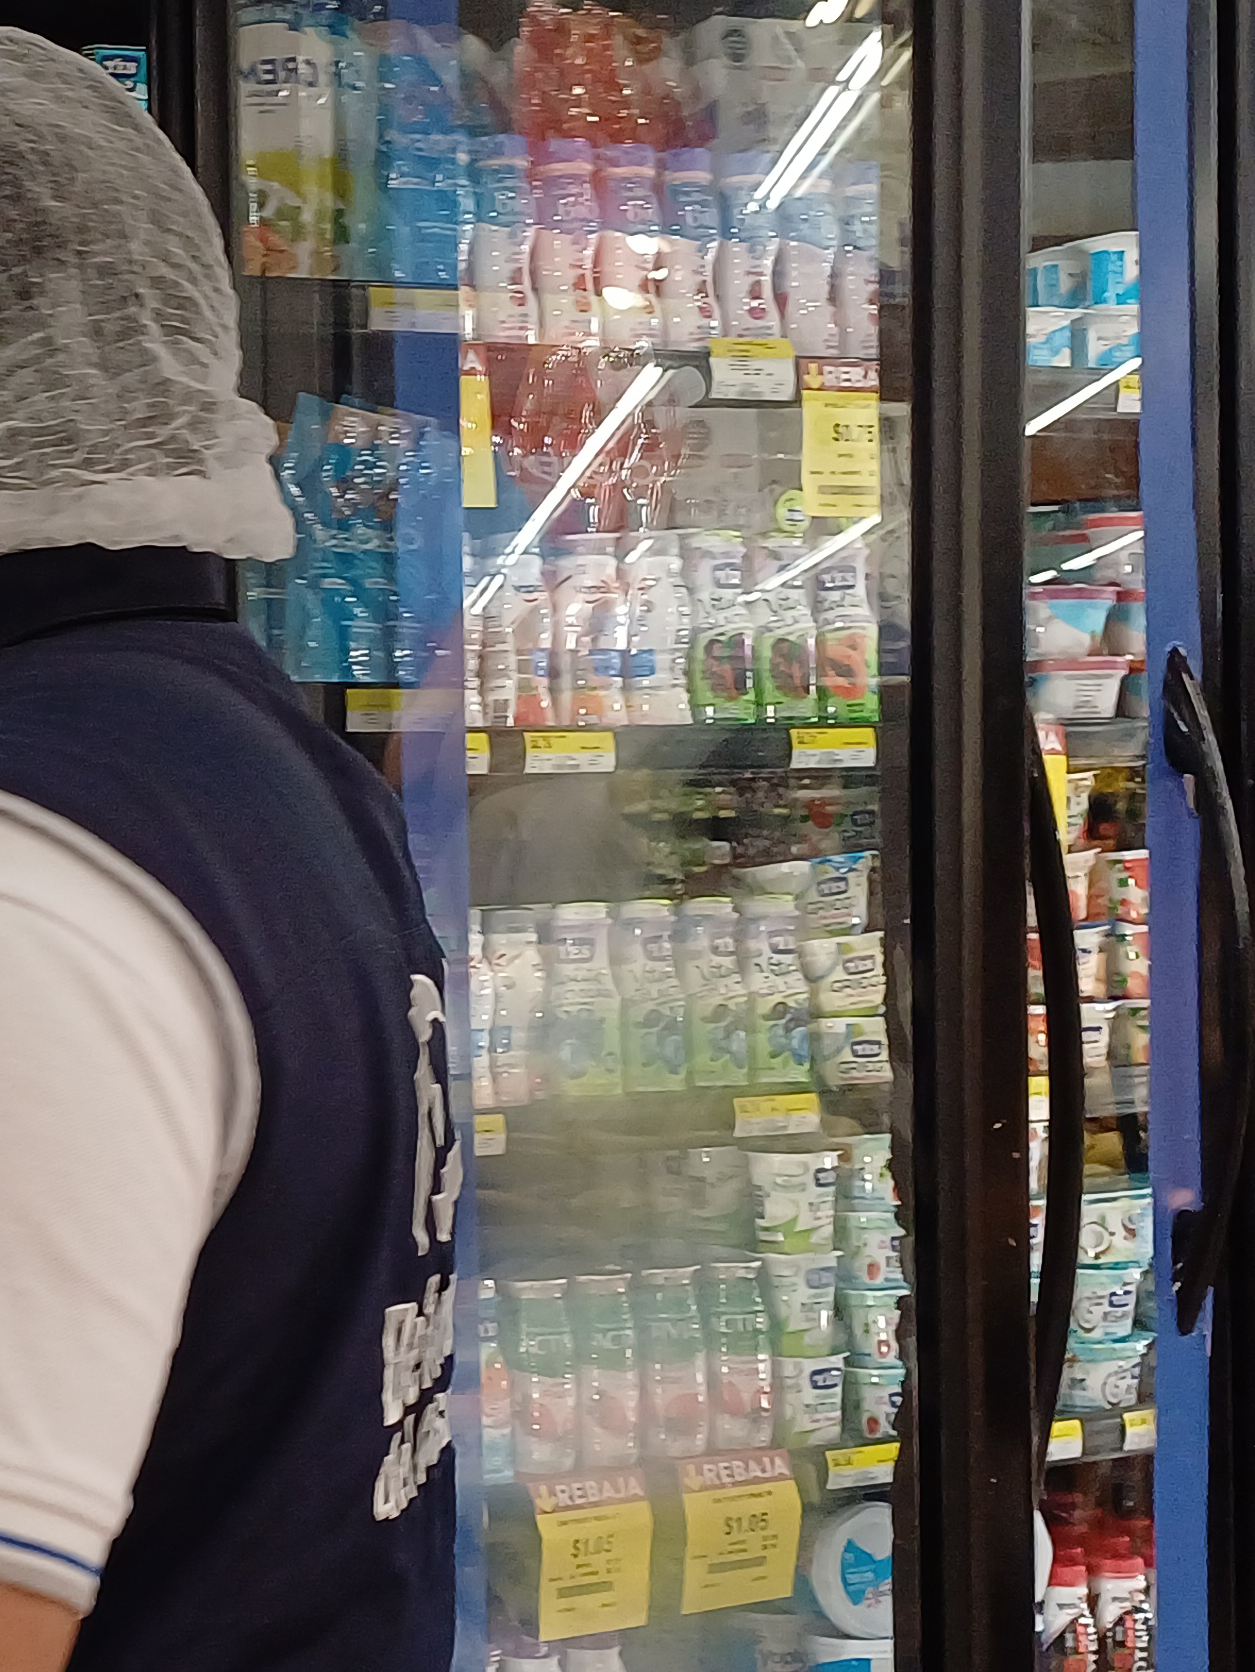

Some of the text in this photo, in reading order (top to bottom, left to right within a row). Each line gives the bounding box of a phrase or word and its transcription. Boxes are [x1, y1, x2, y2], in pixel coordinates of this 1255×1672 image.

[701, 1455, 791, 1486] REBAJA
[553, 1475, 645, 1508] REBAJA
[723, 1511, 770, 1537] $1.05
